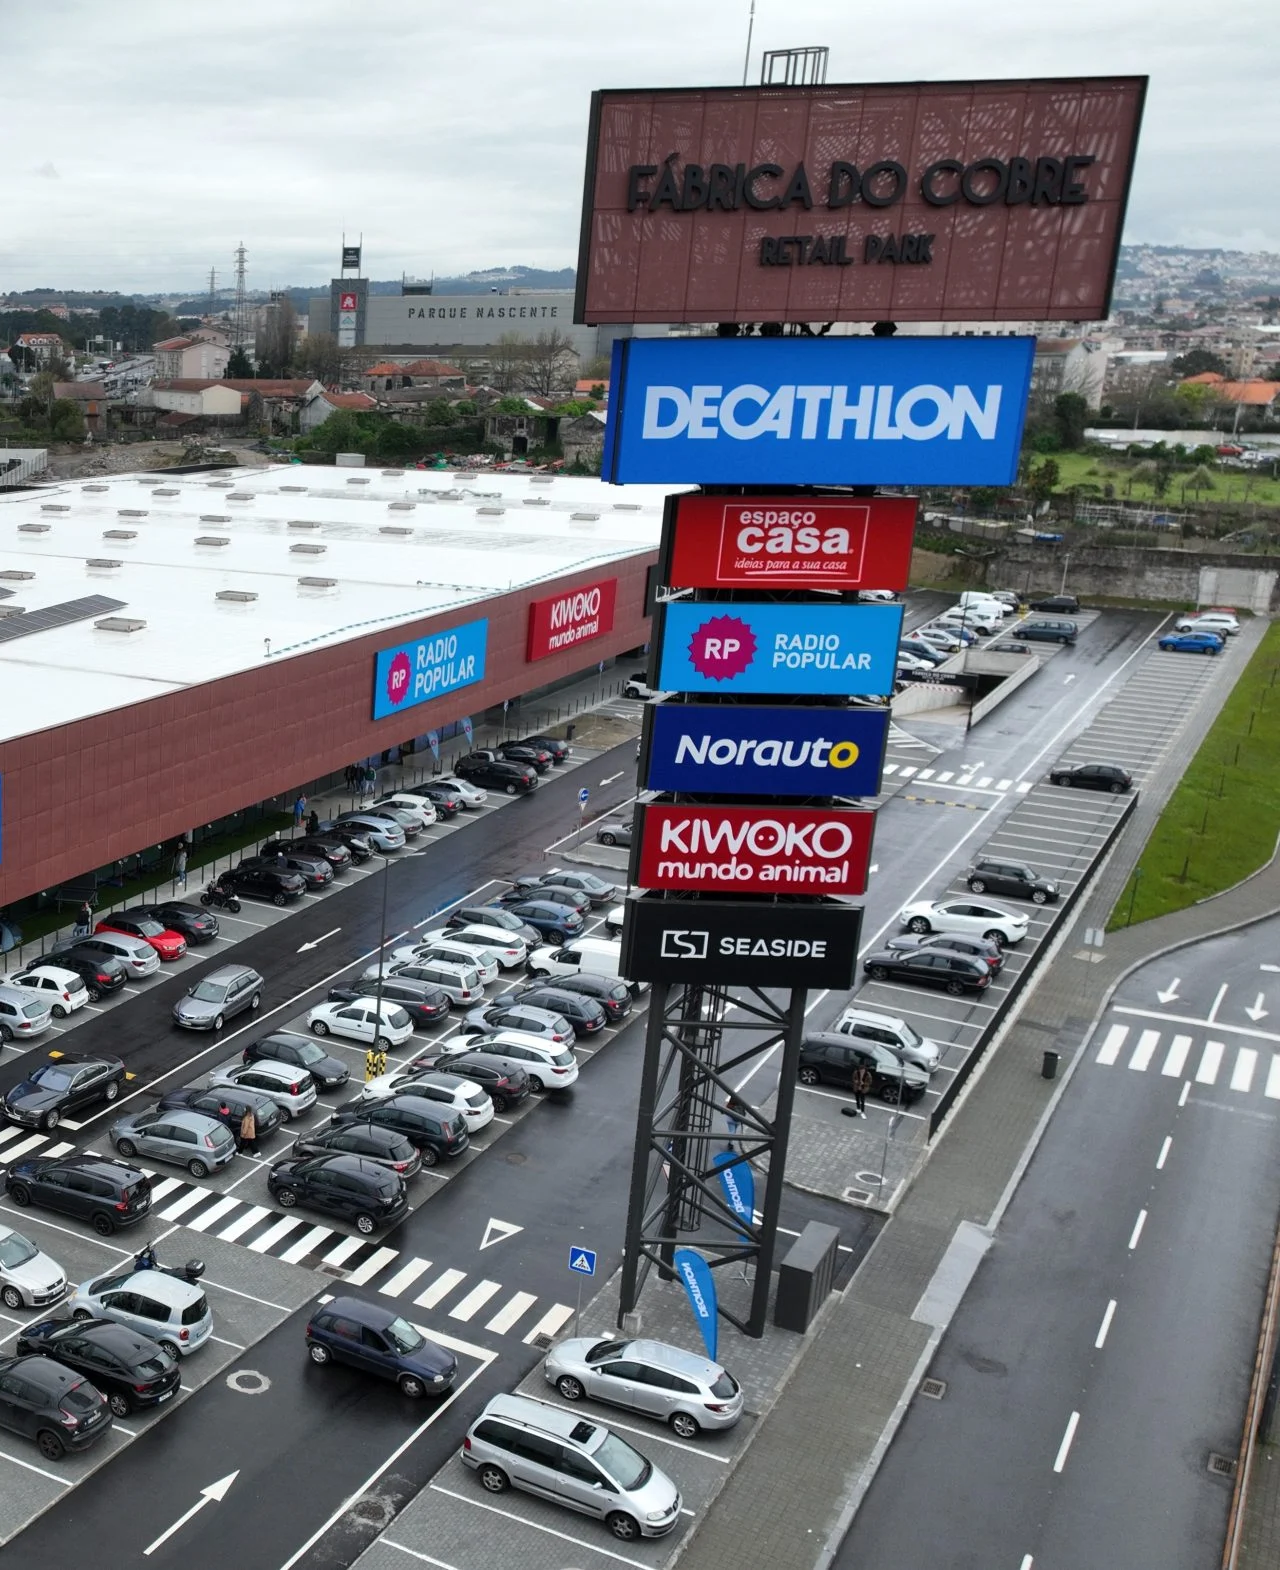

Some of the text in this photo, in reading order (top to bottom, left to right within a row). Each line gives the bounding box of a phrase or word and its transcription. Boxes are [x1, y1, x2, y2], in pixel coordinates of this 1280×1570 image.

[626, 152, 1095, 212] FÁBRICA DO COBRE
[759, 234, 936, 267] RETAIL PARK
[408, 306, 558, 319] PARQUE NASCENTE
[642, 384, 1002, 440] DECATHLON
[739, 510, 816, 529] espaço
[737, 526, 849, 554] casa
[734, 557, 847, 571] ideias para a sua casa
[550, 587, 601, 630] KIWOKO
[548, 620, 599, 651] mundo animal
[704, 638, 740, 660] RP
[774, 633, 839, 651] RADIO
[416, 635, 457, 669] RADIO
[772, 651, 872, 670] POPULAR
[392, 669, 406, 690] RP
[415, 655, 475, 698] POPULAR
[674, 735, 859, 768] Norauto
[660, 819, 852, 858] KIWOKO
[657, 857, 849, 883] mundo animal
[719, 937, 827, 958] SEASIDE
